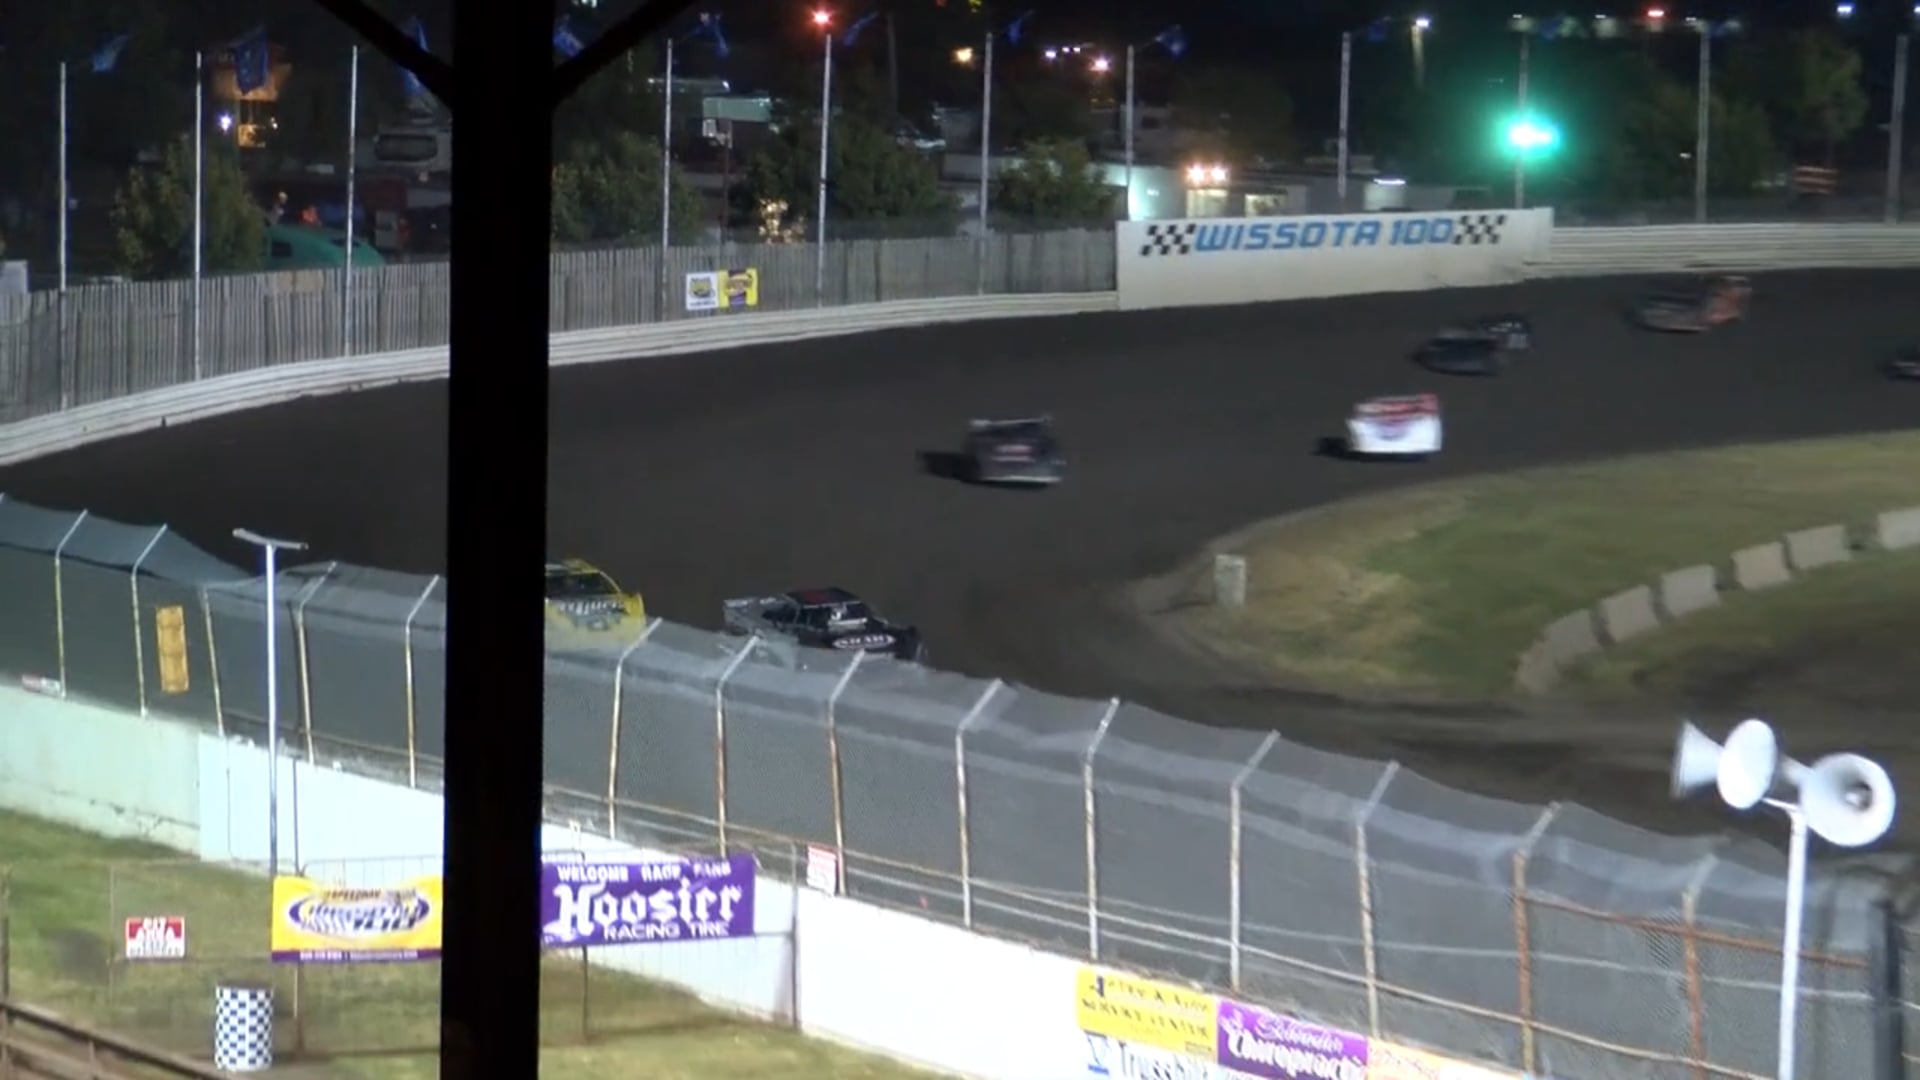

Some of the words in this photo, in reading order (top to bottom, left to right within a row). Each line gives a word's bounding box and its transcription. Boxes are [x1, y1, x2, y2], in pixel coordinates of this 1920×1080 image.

[1194, 219, 1380, 251] WISSOTA
[1388, 217, 1455, 246] 100
[557, 864, 628, 882] WELCOME
[640, 863, 682, 881] RACE
[543, 876, 742, 942] Hoosier
[603, 921, 680, 941] RACING
[688, 919, 730, 938] TIRE
